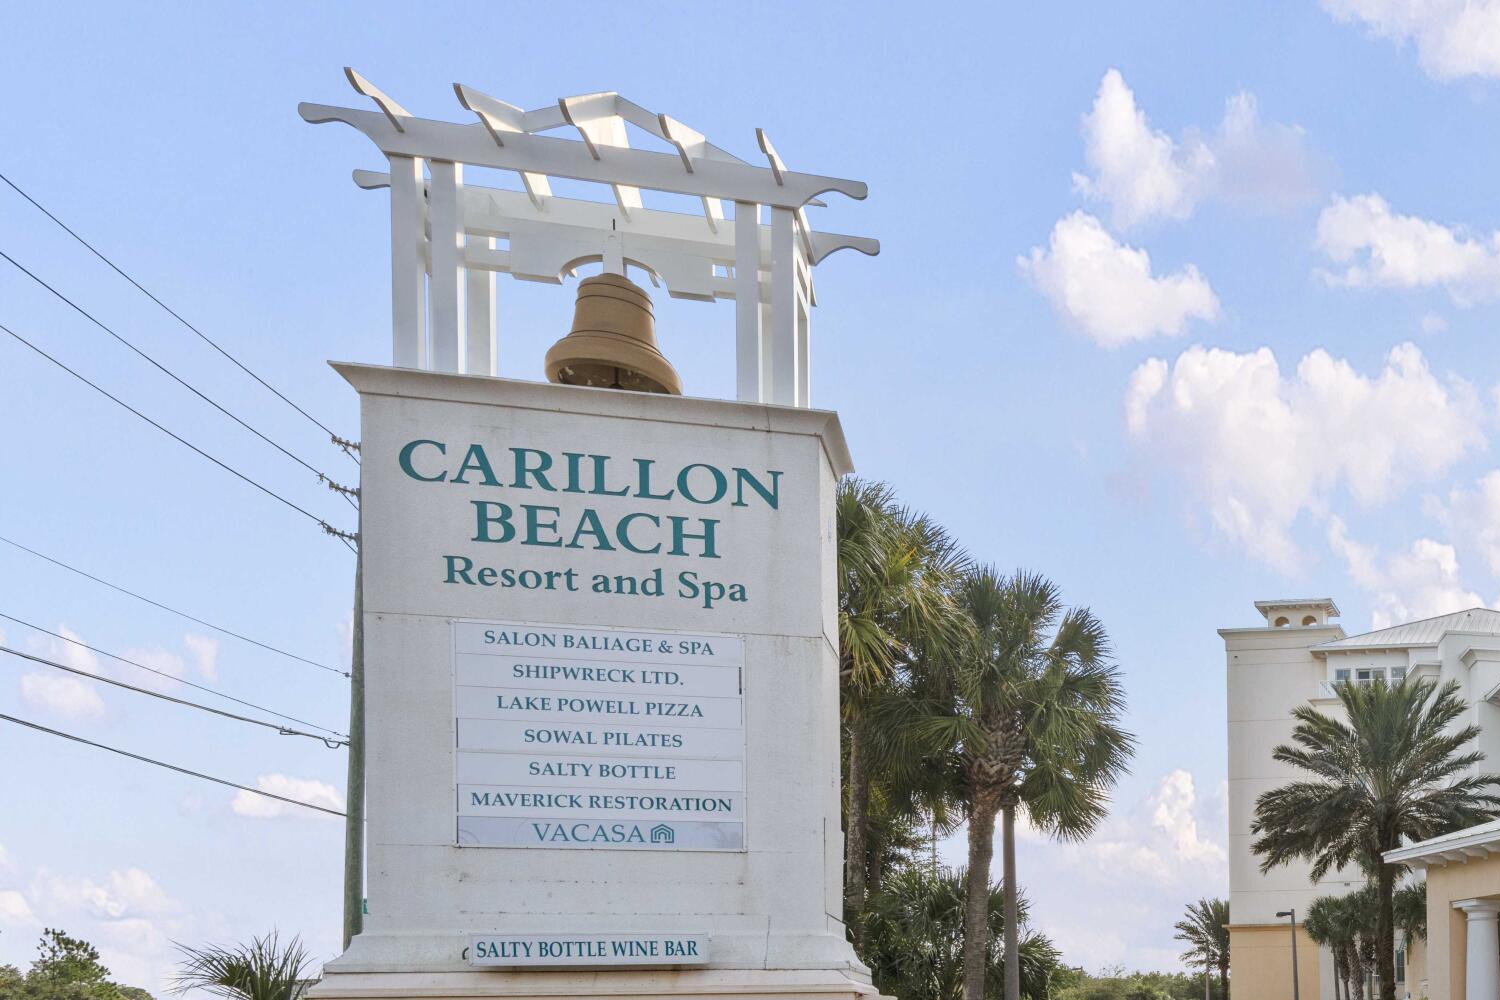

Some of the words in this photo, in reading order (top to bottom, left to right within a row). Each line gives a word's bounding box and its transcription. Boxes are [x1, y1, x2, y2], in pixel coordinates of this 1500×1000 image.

[398, 438, 784, 510] CARILLON
[470, 500, 722, 559] BEACH
[442, 555, 579, 592] Resort
[591, 568, 665, 598] and
[678, 571, 749, 609] Spa
[484, 630, 556, 648] SALON
[563, 634, 653, 653] BALIAGE
[658, 640, 673, 654] &
[679, 641, 715, 656] SPA
[512, 664, 636, 683] SHIPWRECK
[641, 670, 684, 686] LTD.
[497, 695, 551, 711] LAKE
[557, 698, 640, 715] POWELL
[645, 702, 704, 718] PIZZA
[524, 729, 598, 745] SOWAL
[603, 731, 683, 748] PILATES
[529, 761, 593, 777] SALTY
[599, 764, 676, 780] BOTTLE
[471, 792, 584, 809] MAVERICK
[589, 796, 732, 812] RESTORATION
[532, 823, 646, 843] VACASA
[476, 941, 533, 958] SALTY
[538, 941, 607, 957] BOTTLE
[611, 940, 659, 957] WINE
[665, 940, 699, 956] BAR
